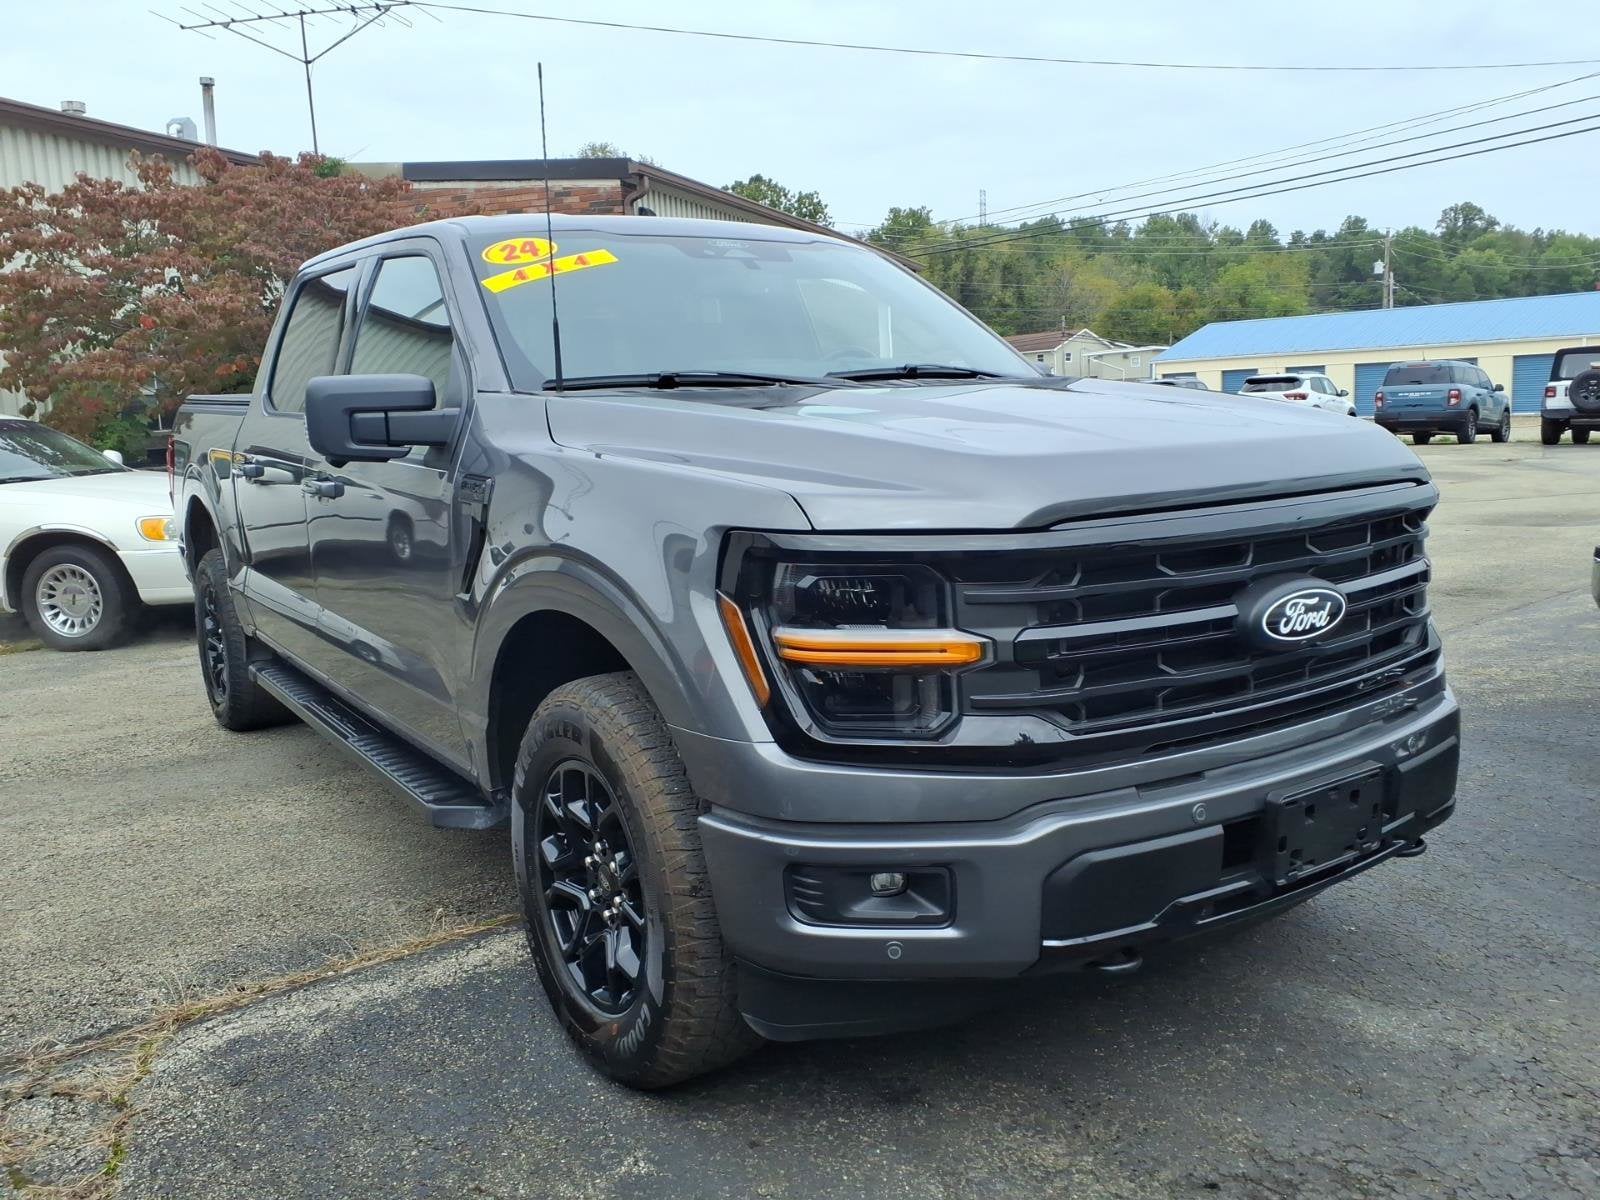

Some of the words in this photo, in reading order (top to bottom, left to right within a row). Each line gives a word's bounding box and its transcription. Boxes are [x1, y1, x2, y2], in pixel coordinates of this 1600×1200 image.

[499, 240, 540, 262] 24
[513, 269, 529, 281] 4
[574, 254, 590, 266] 4
[1280, 596, 1331, 634] Ford
